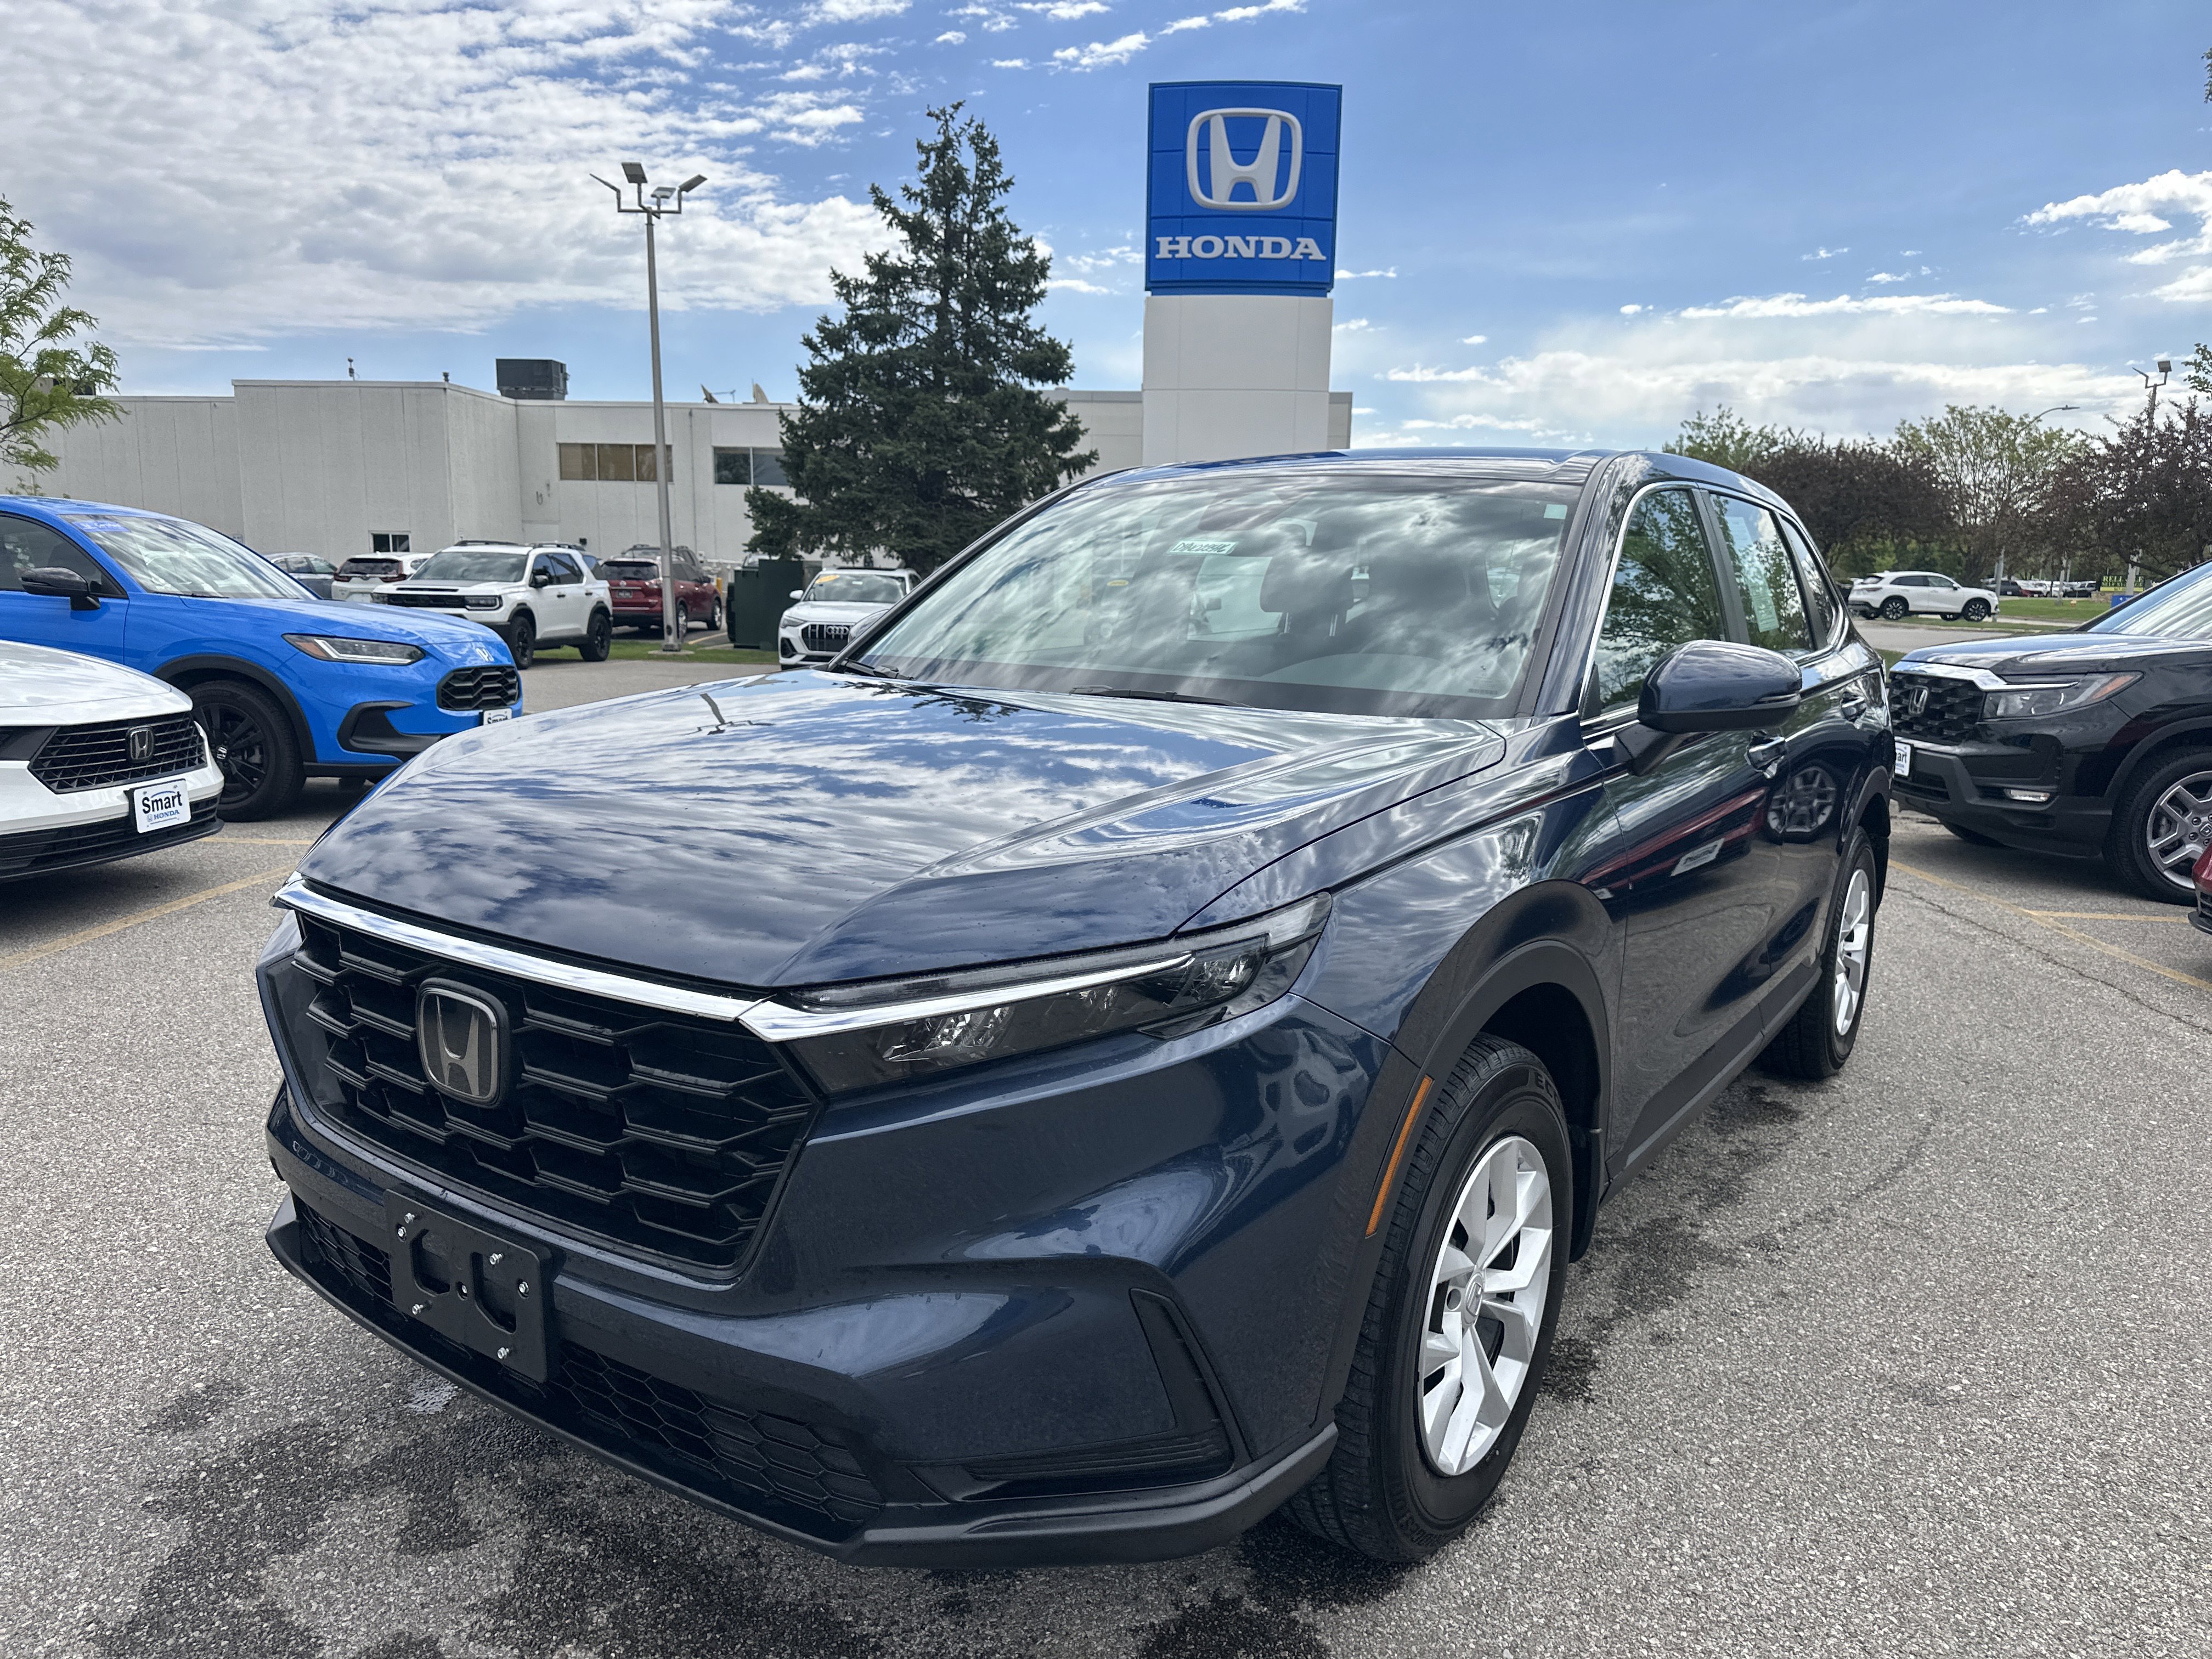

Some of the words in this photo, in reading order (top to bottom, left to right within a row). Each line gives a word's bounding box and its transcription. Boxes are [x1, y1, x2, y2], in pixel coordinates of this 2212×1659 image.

[1155, 235, 1327, 261] HONDA
[1897, 752, 1907, 764] art
[142, 791, 183, 814] Smart
[154, 809, 180, 820] HONDA
